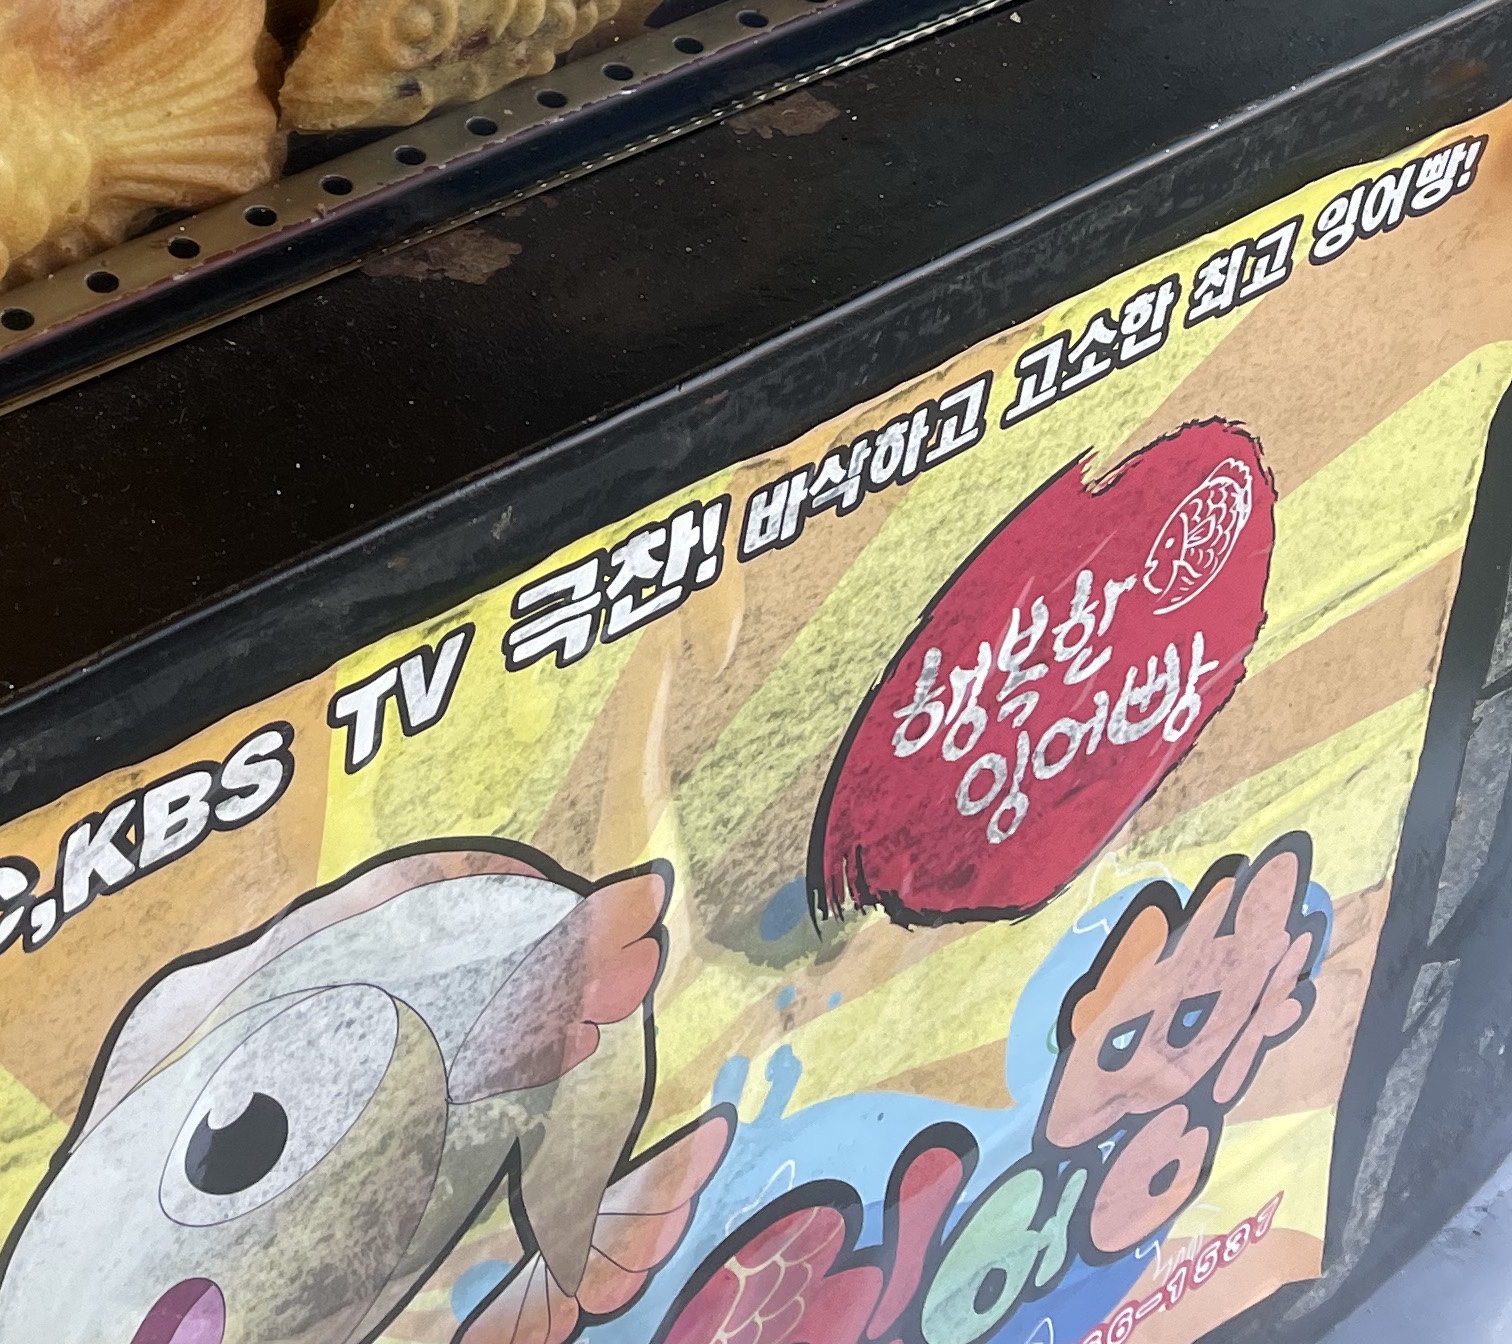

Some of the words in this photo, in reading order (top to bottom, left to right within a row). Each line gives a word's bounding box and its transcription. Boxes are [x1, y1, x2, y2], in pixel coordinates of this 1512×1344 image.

[332, 628, 469, 767] TV
[506, 499, 726, 666] 극찬!
[741, 374, 989, 557] 바삭하고
[1002, 276, 1183, 424] 고소한
[1187, 218, 1300, 323] 최고
[1310, 138, 1485, 262] 잉어빵!
[892, 569, 1138, 761] 행복한
[956, 631, 1219, 844] 잉어빵
